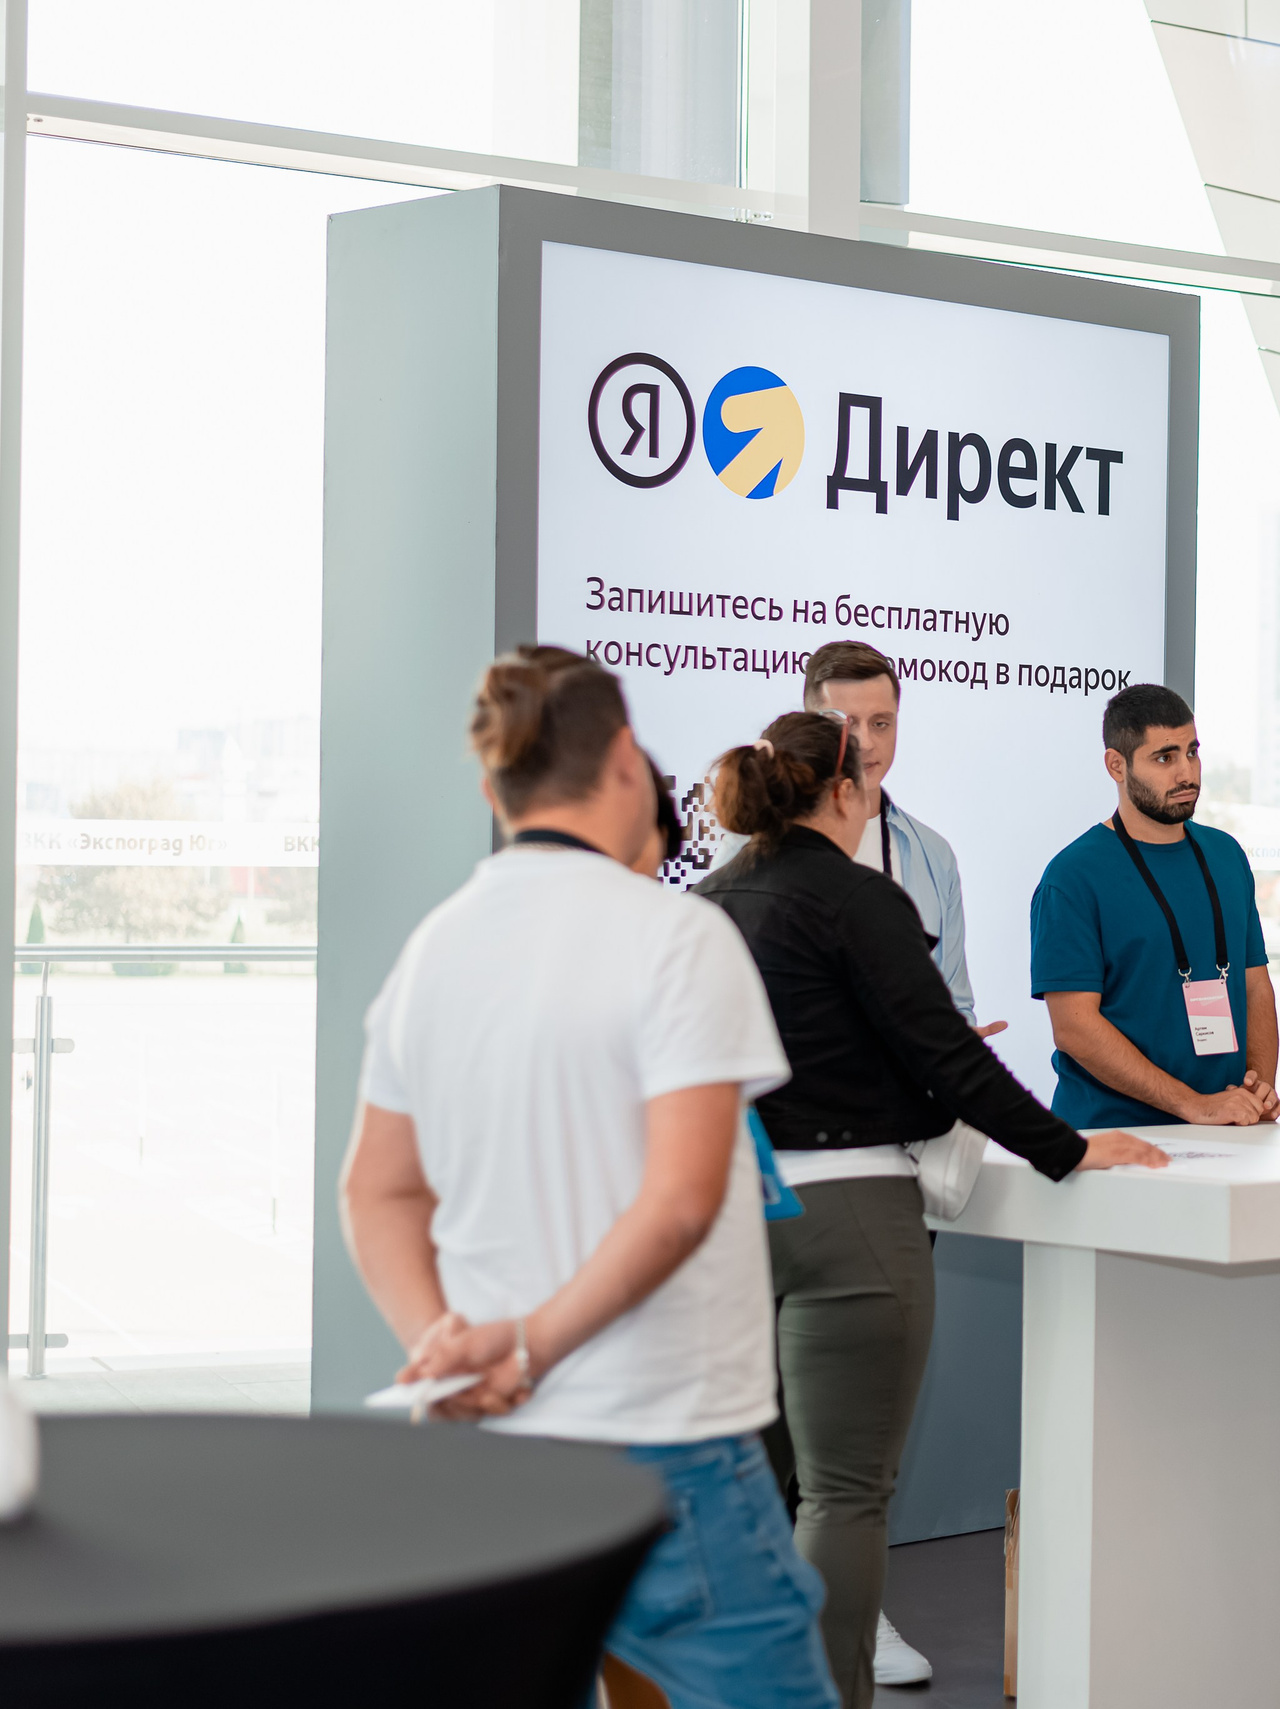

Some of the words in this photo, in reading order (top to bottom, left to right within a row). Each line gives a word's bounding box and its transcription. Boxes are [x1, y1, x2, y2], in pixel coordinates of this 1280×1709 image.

[826, 391, 1124, 521] Директ
[586, 576, 784, 622] Запишитесь
[792, 599, 827, 625] на
[835, 594, 1010, 642] бесплатную
[996, 662, 1010, 685] в
[1018, 663, 1132, 696] подарок
